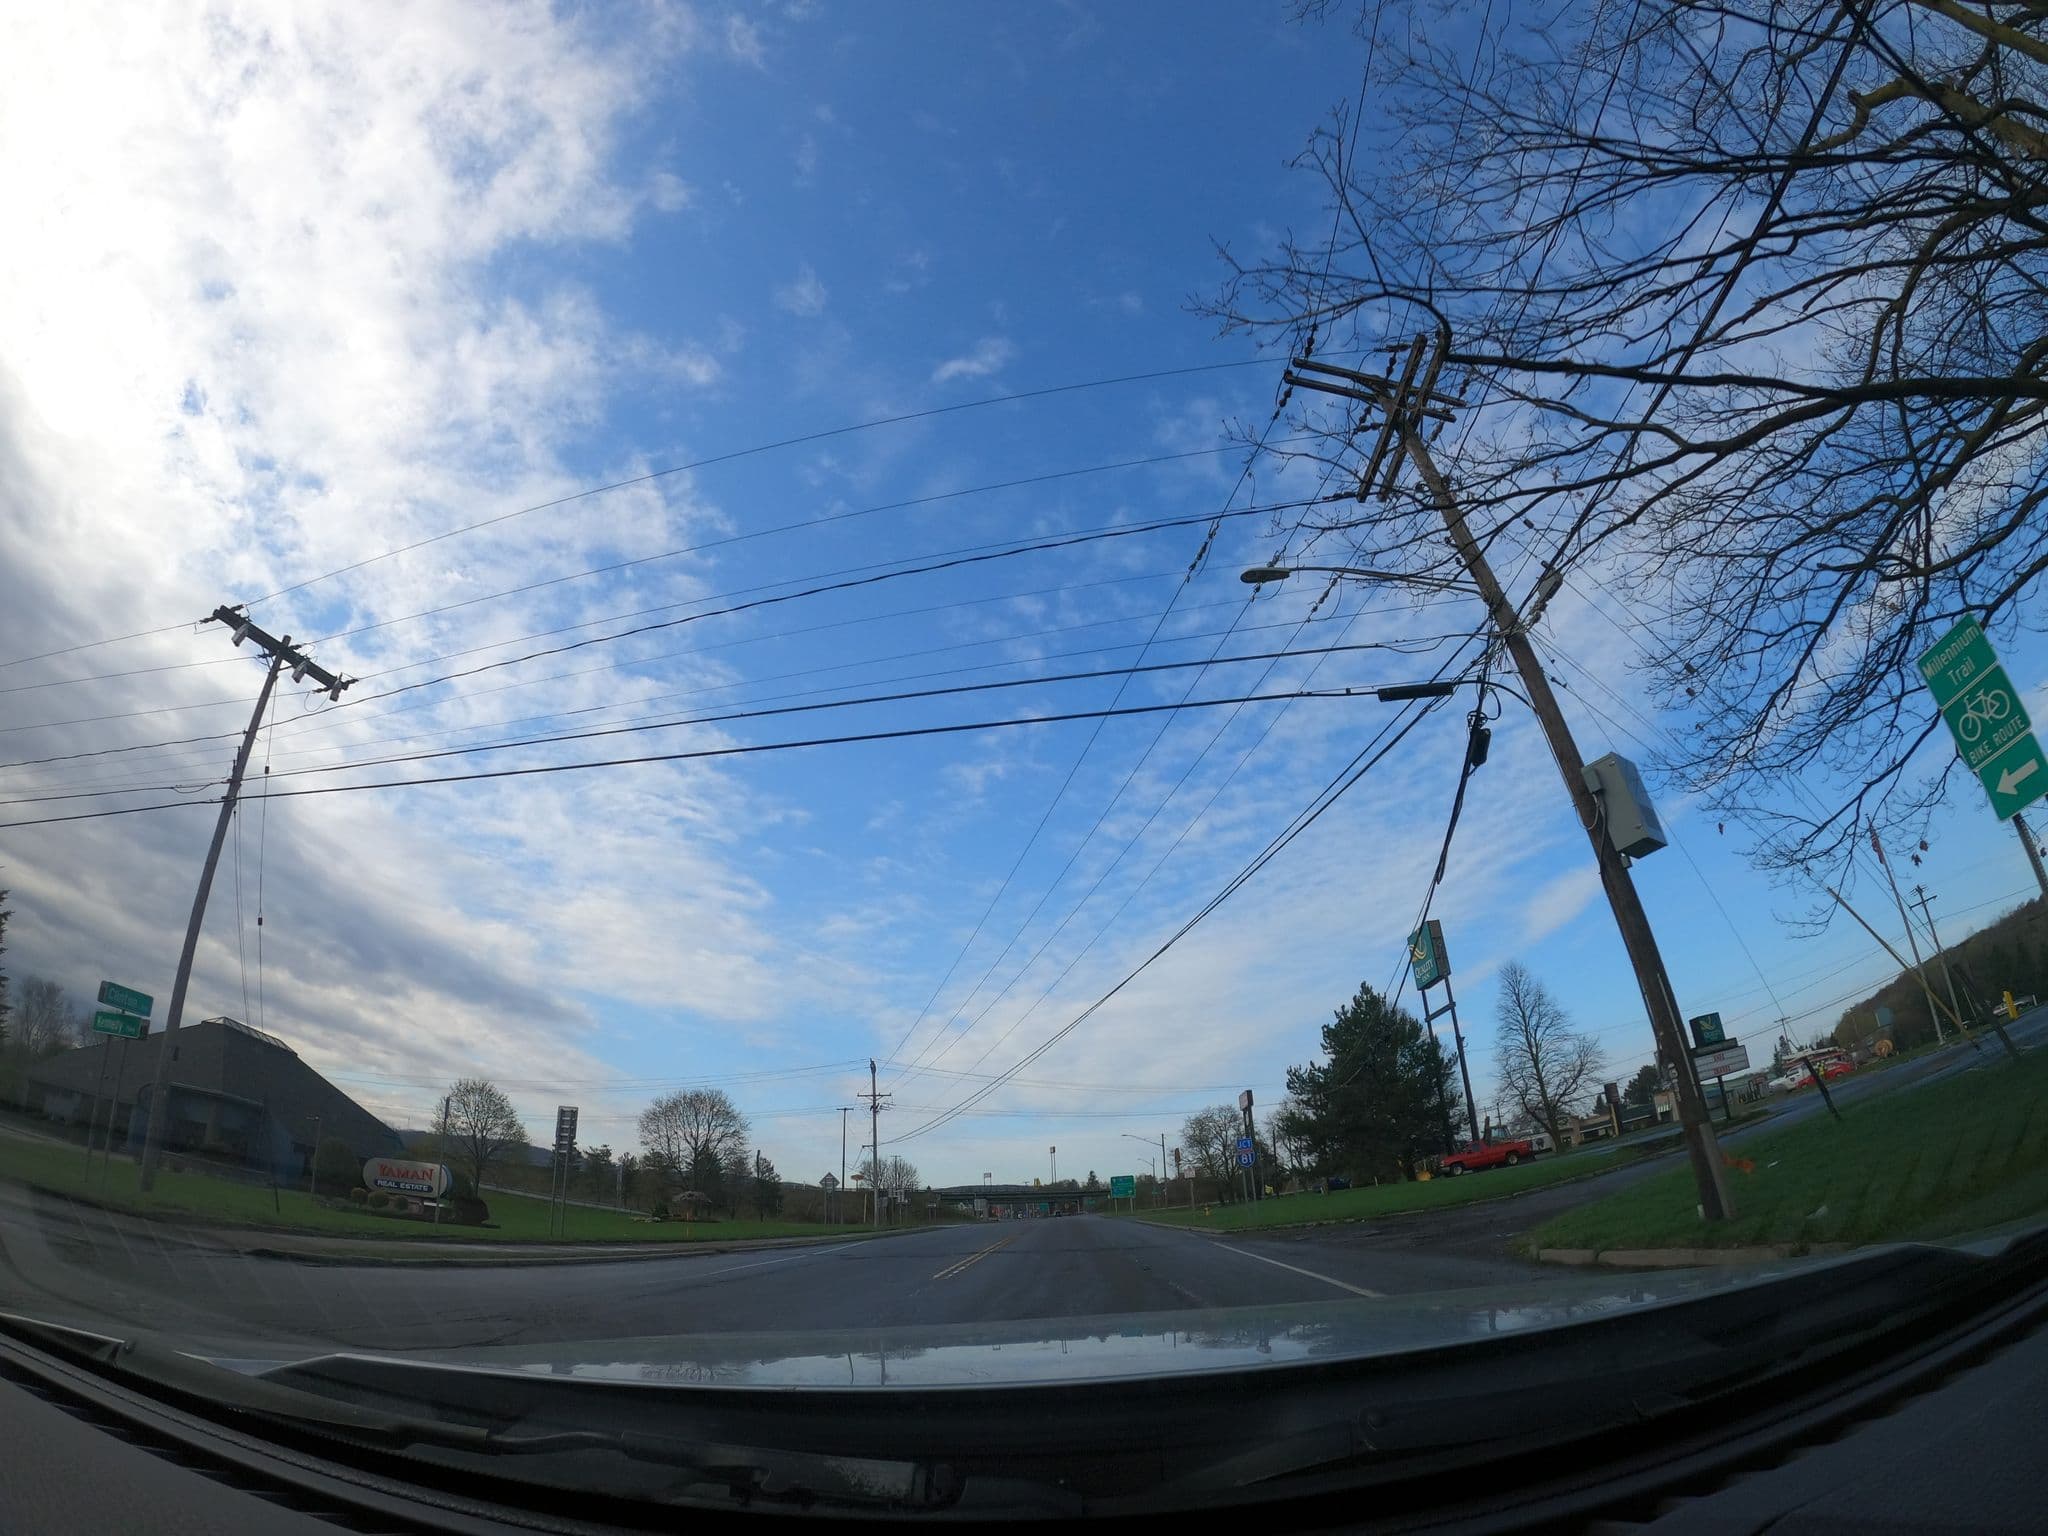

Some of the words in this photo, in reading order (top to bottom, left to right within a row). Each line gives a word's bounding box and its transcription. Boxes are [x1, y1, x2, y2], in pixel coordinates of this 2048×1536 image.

[1922, 624, 1980, 680] Millennium
[1947, 655, 1976, 687] Trail
[1968, 740, 1993, 765] BIKE
[1992, 714, 2025, 747] ROUTE
[1239, 1139, 1251, 1149] JCT
[1241, 1154, 1252, 1164] 81
[377, 1179, 398, 1189] REAL
[400, 1182, 429, 1192] ESTATE
